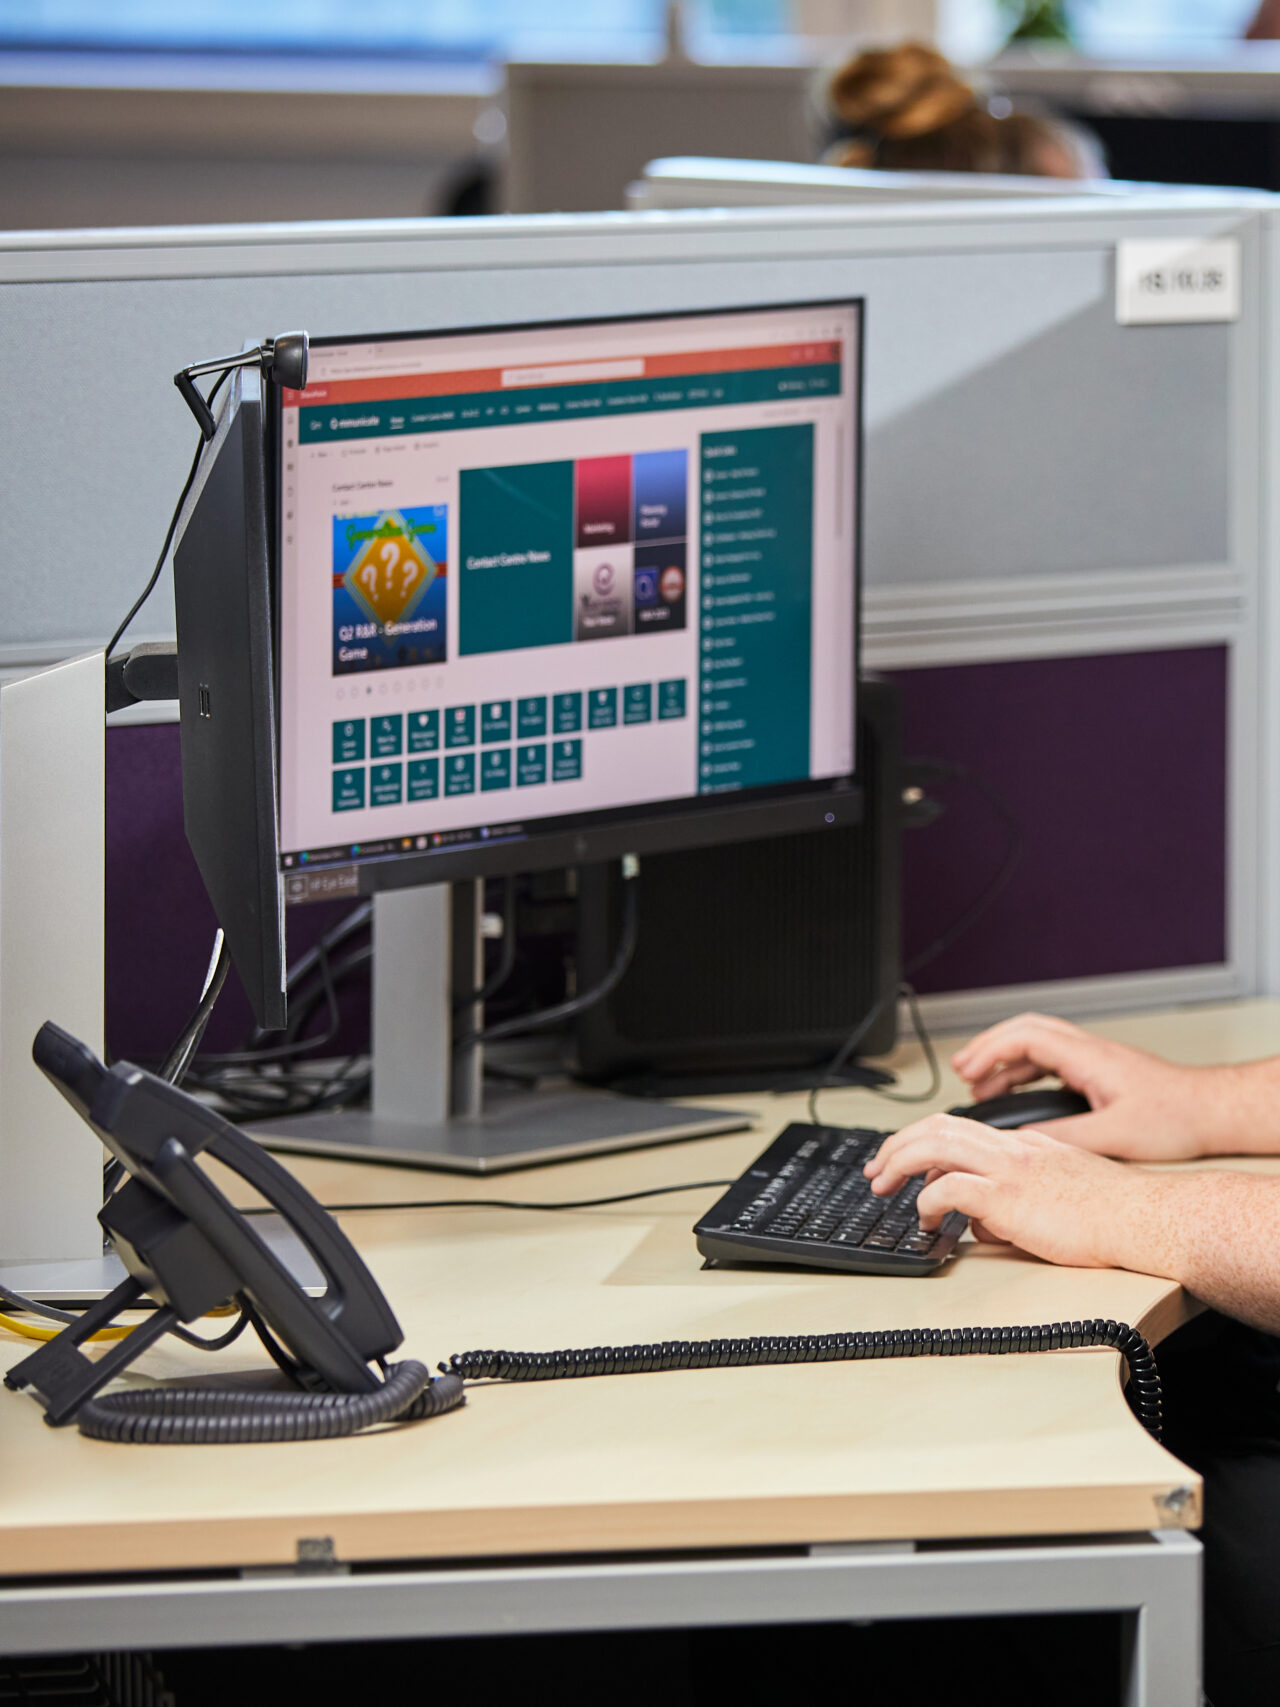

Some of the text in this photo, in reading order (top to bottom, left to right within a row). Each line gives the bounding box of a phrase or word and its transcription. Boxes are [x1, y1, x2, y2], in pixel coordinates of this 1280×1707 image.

[466, 549, 551, 570] Contact Centre News
[338, 625, 354, 642] Q2
[355, 622, 377, 639] R&R
[384, 618, 438, 636] Generation
[338, 646, 368, 662] Game
